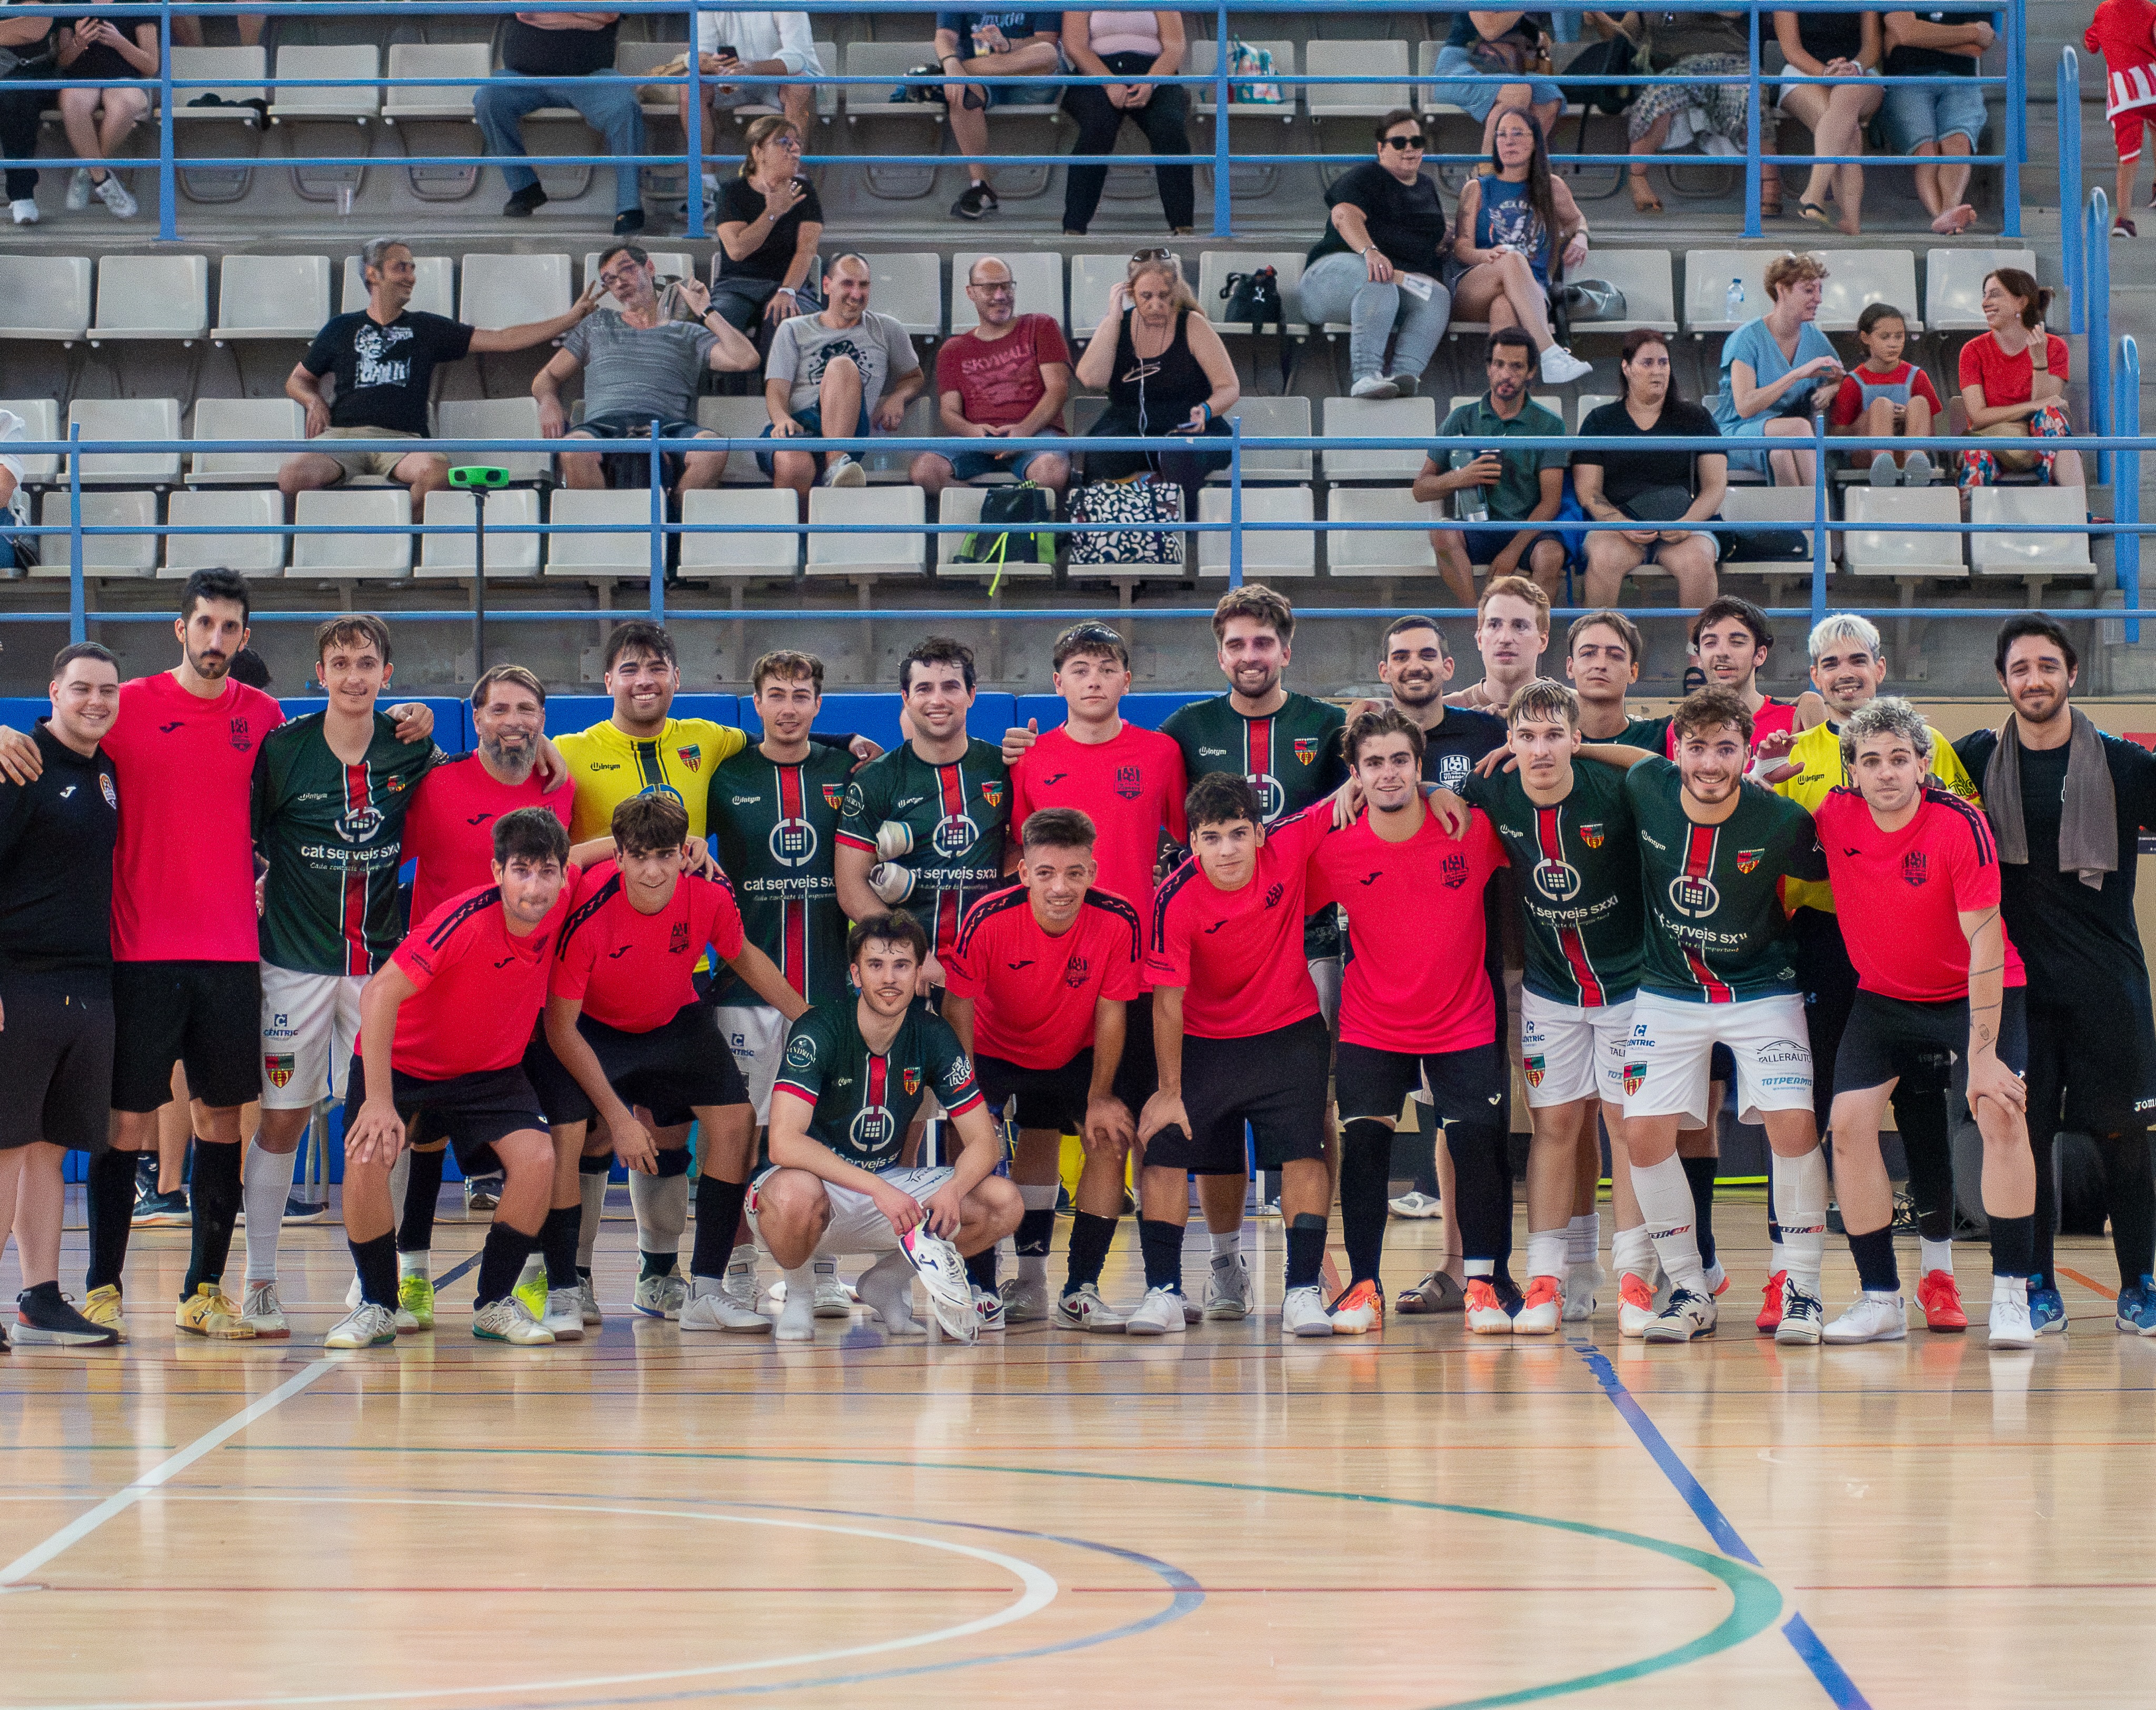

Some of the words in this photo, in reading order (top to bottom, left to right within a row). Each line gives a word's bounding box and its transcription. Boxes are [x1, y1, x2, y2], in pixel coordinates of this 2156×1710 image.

[301, 844, 325, 859] cat
[326, 848, 380, 860] serveis
[924, 866, 974, 879] serveis
[744, 878, 764, 890] cat
[766, 875, 819, 889] serveis
[821, 877, 835, 887] sx
[1536, 907, 1588, 920] serveis
[2134, 1098, 2156, 1112] Jom
